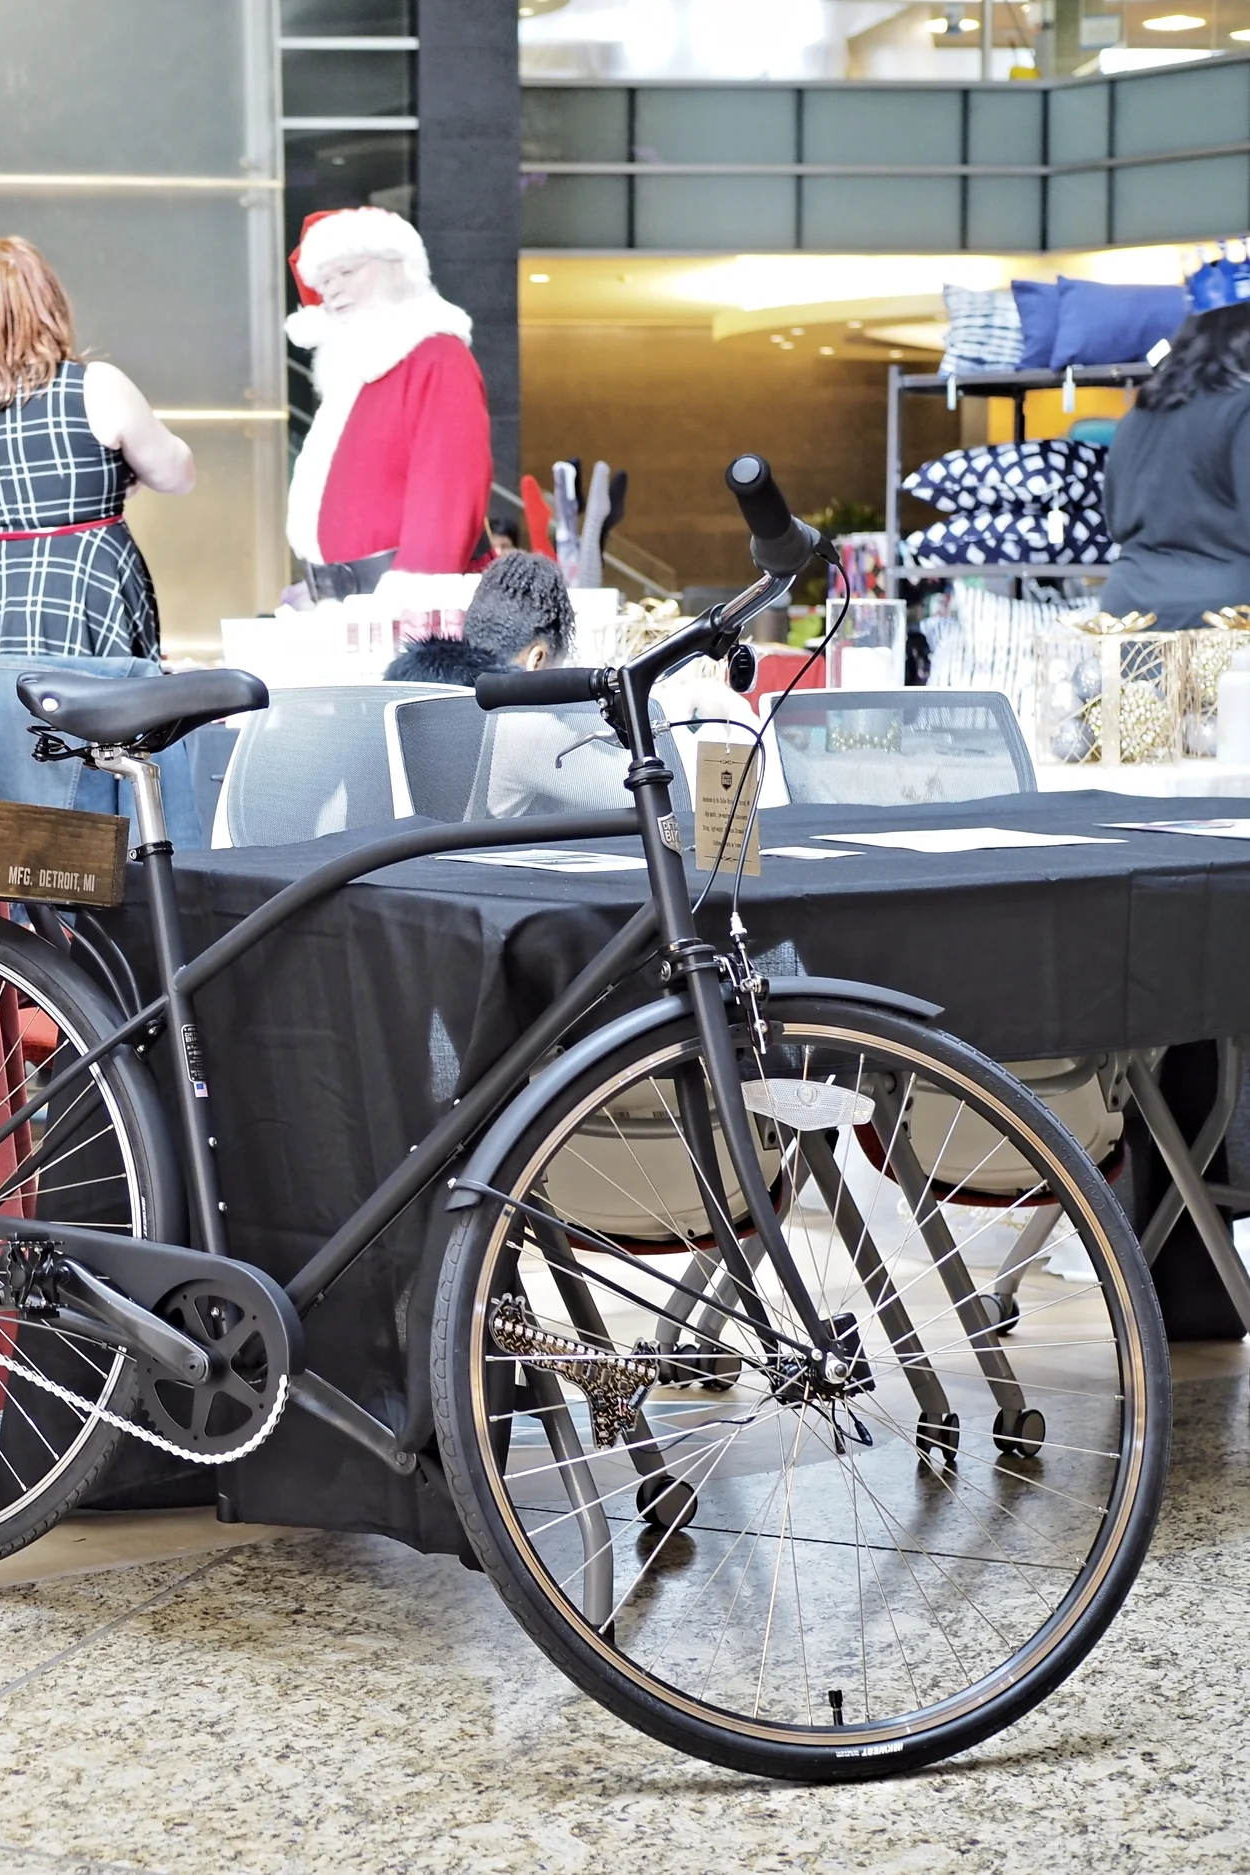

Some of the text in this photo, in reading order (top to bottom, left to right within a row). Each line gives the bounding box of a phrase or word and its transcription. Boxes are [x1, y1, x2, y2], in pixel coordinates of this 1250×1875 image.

[664, 830, 681, 842] BIK
[8, 865, 96, 892] MFG. DETROIT, MI
